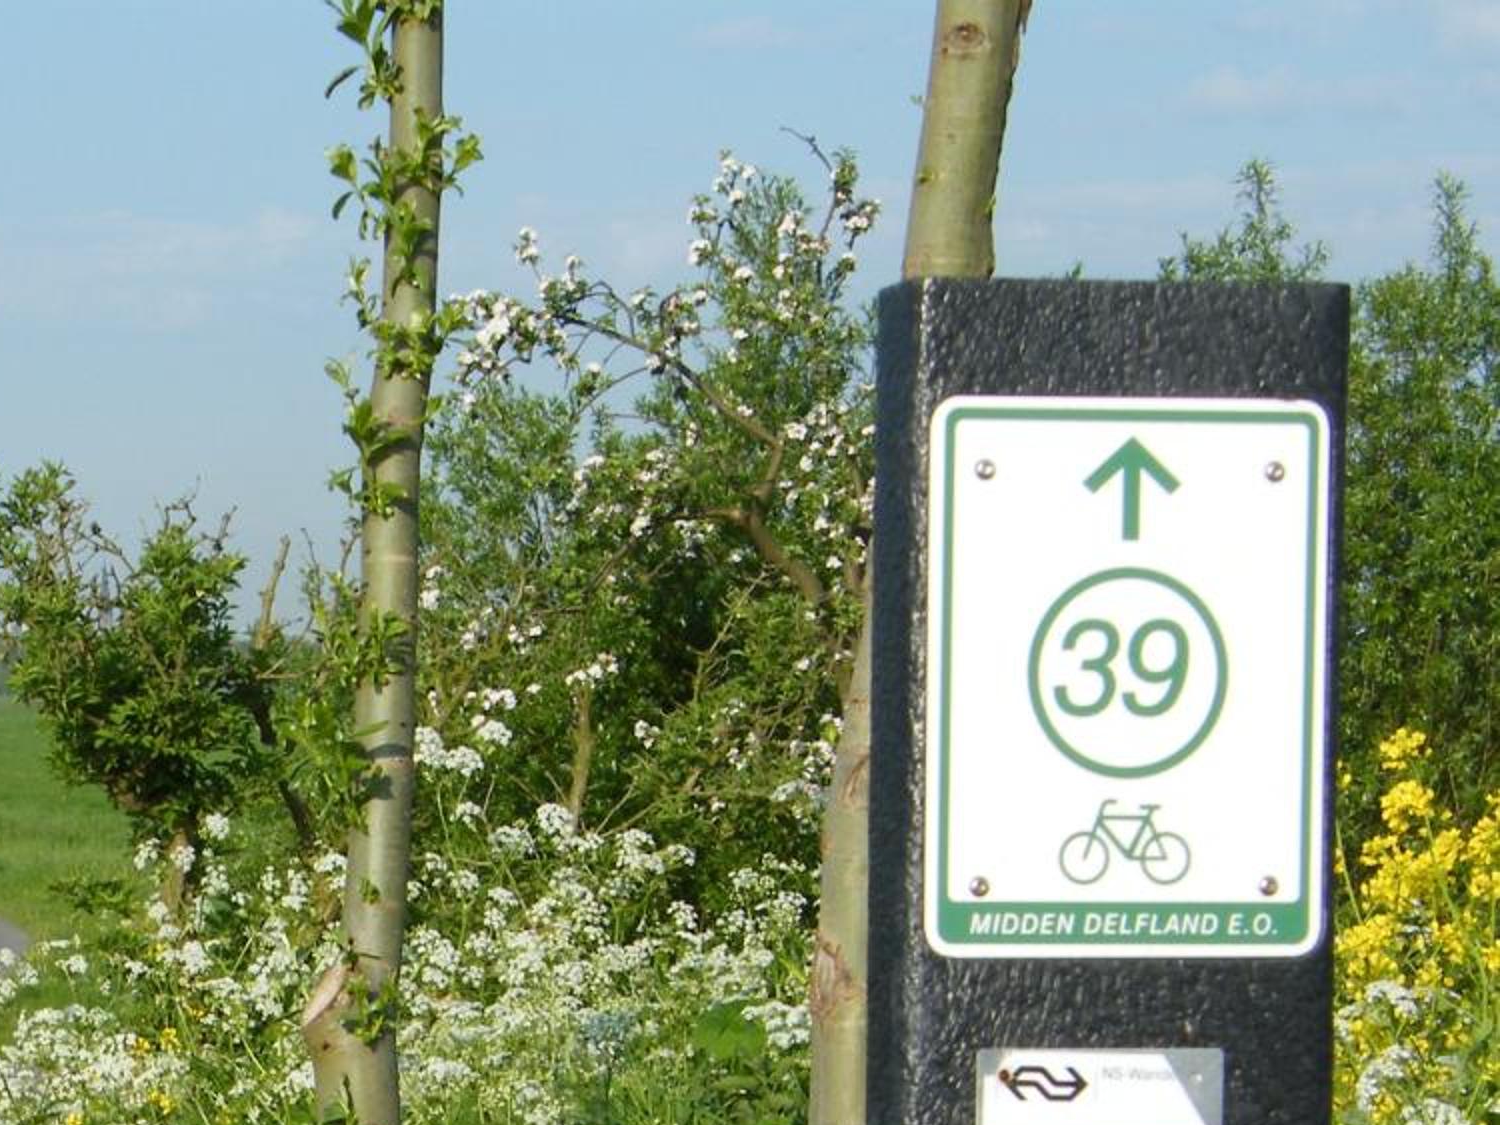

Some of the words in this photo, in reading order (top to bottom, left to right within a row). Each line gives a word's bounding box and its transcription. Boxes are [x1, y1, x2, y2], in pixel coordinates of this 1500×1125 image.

[1054, 619, 1190, 717] 39
[969, 912, 1075, 935] MIDDEN
[1083, 913, 1219, 936] DELFLAND
[1227, 914, 1277, 936] E.O.
